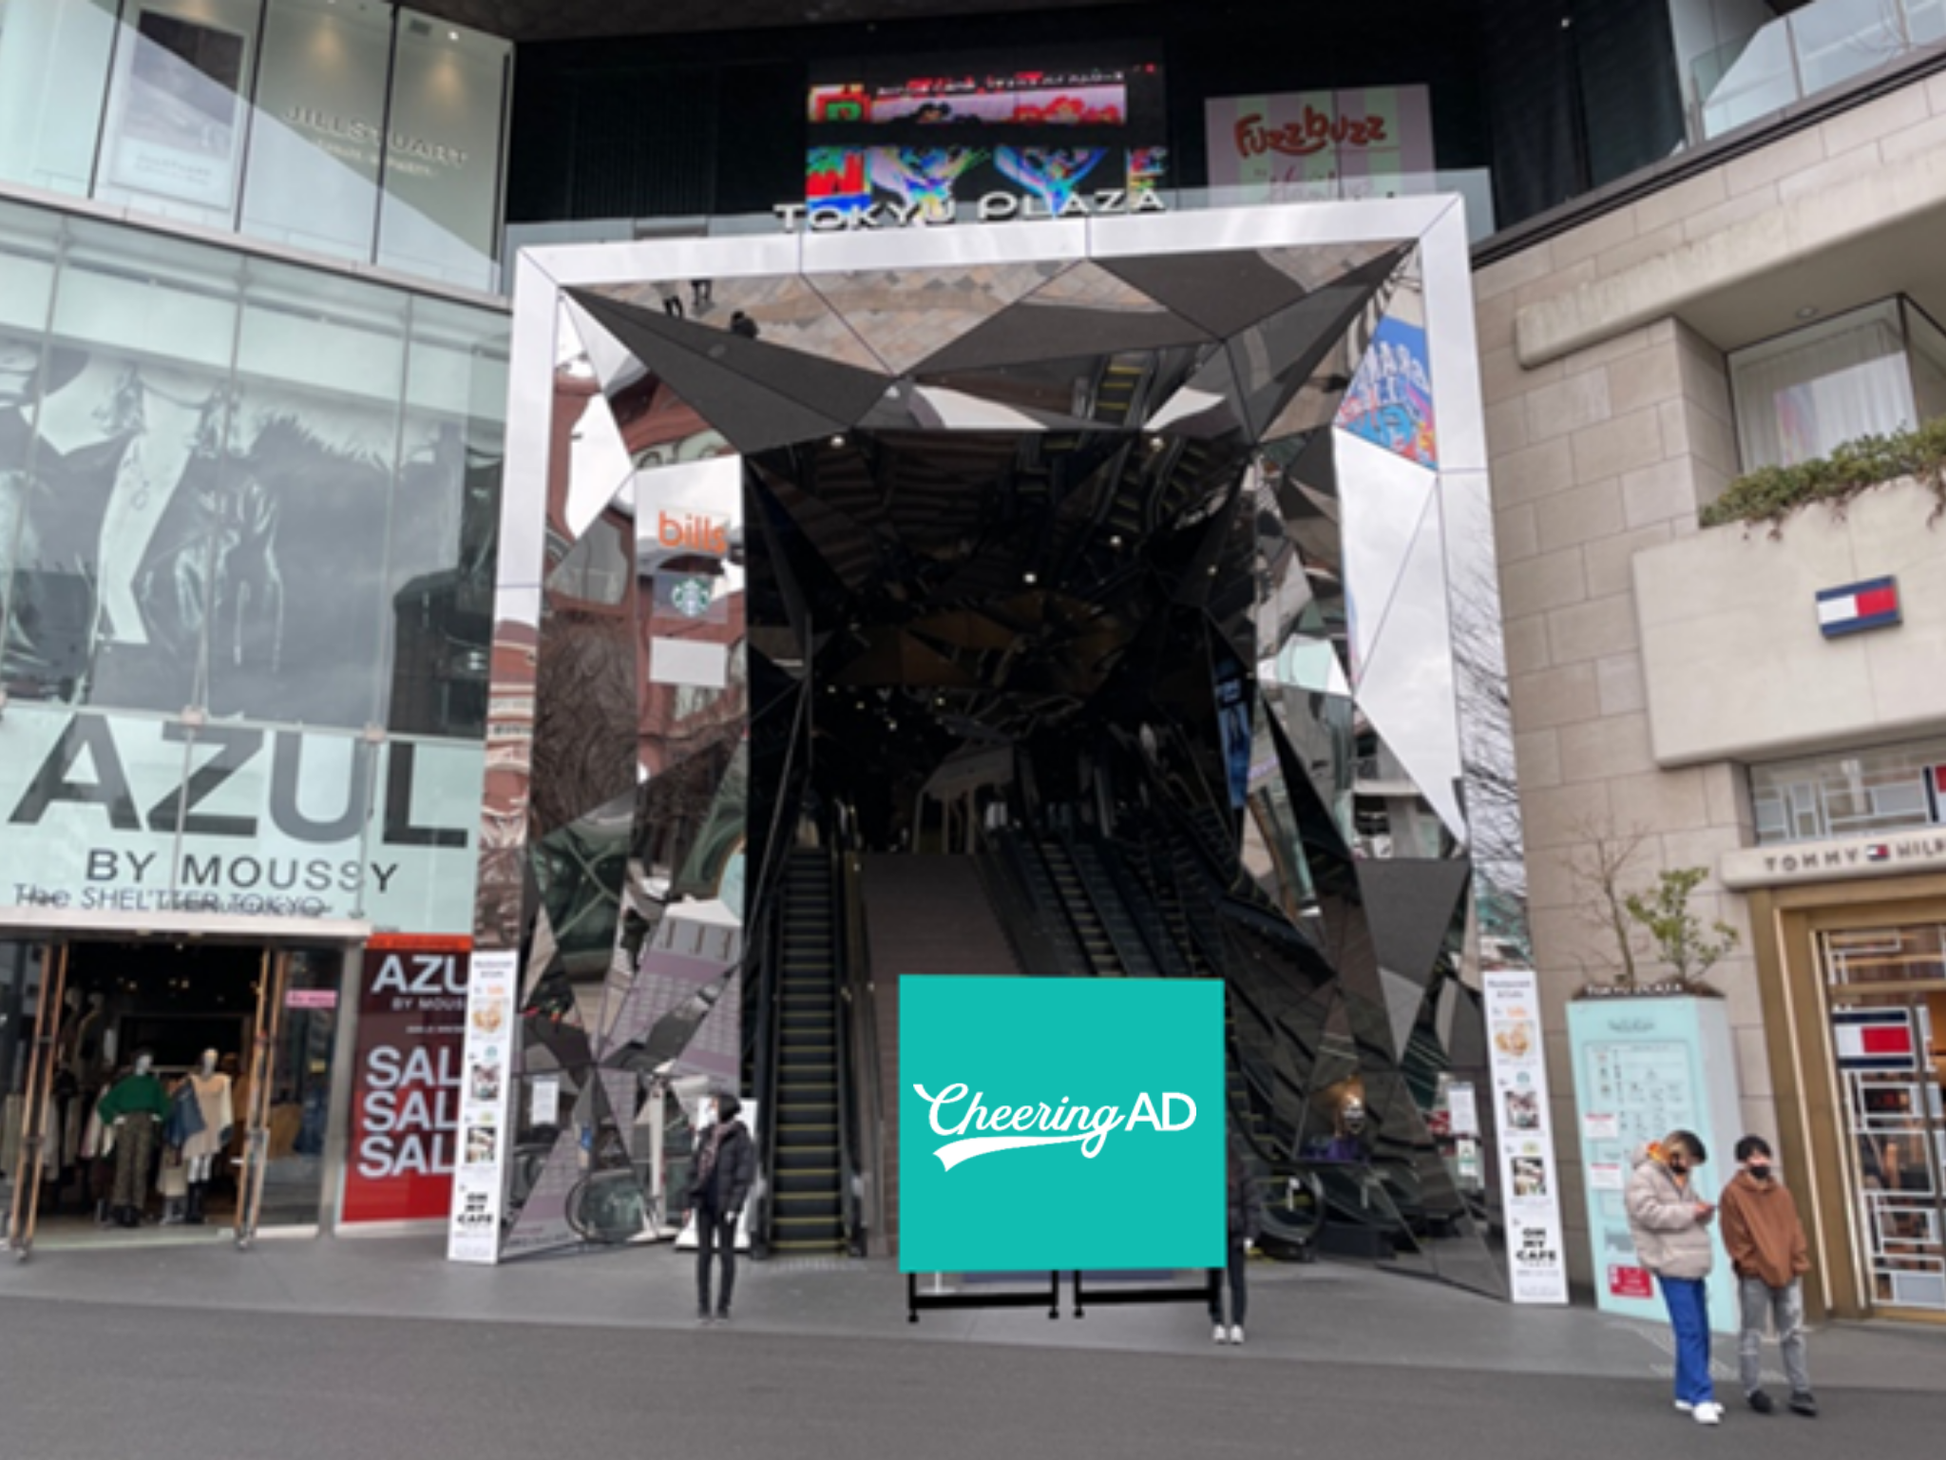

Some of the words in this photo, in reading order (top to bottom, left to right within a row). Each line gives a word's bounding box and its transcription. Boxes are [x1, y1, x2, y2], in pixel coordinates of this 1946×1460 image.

[773, 201, 956, 233] TOKYU
[978, 191, 1166, 222] PLAZA
[658, 509, 728, 556] bills
[8, 712, 470, 850] AZUL
[86, 848, 157, 884] BY
[180, 854, 398, 892] MOUSSY
[1764, 848, 1858, 873] TOMMY
[14, 883, 72, 909] The
[913, 1082, 1126, 1158] Cheering
[1124, 1092, 1197, 1131] AD
